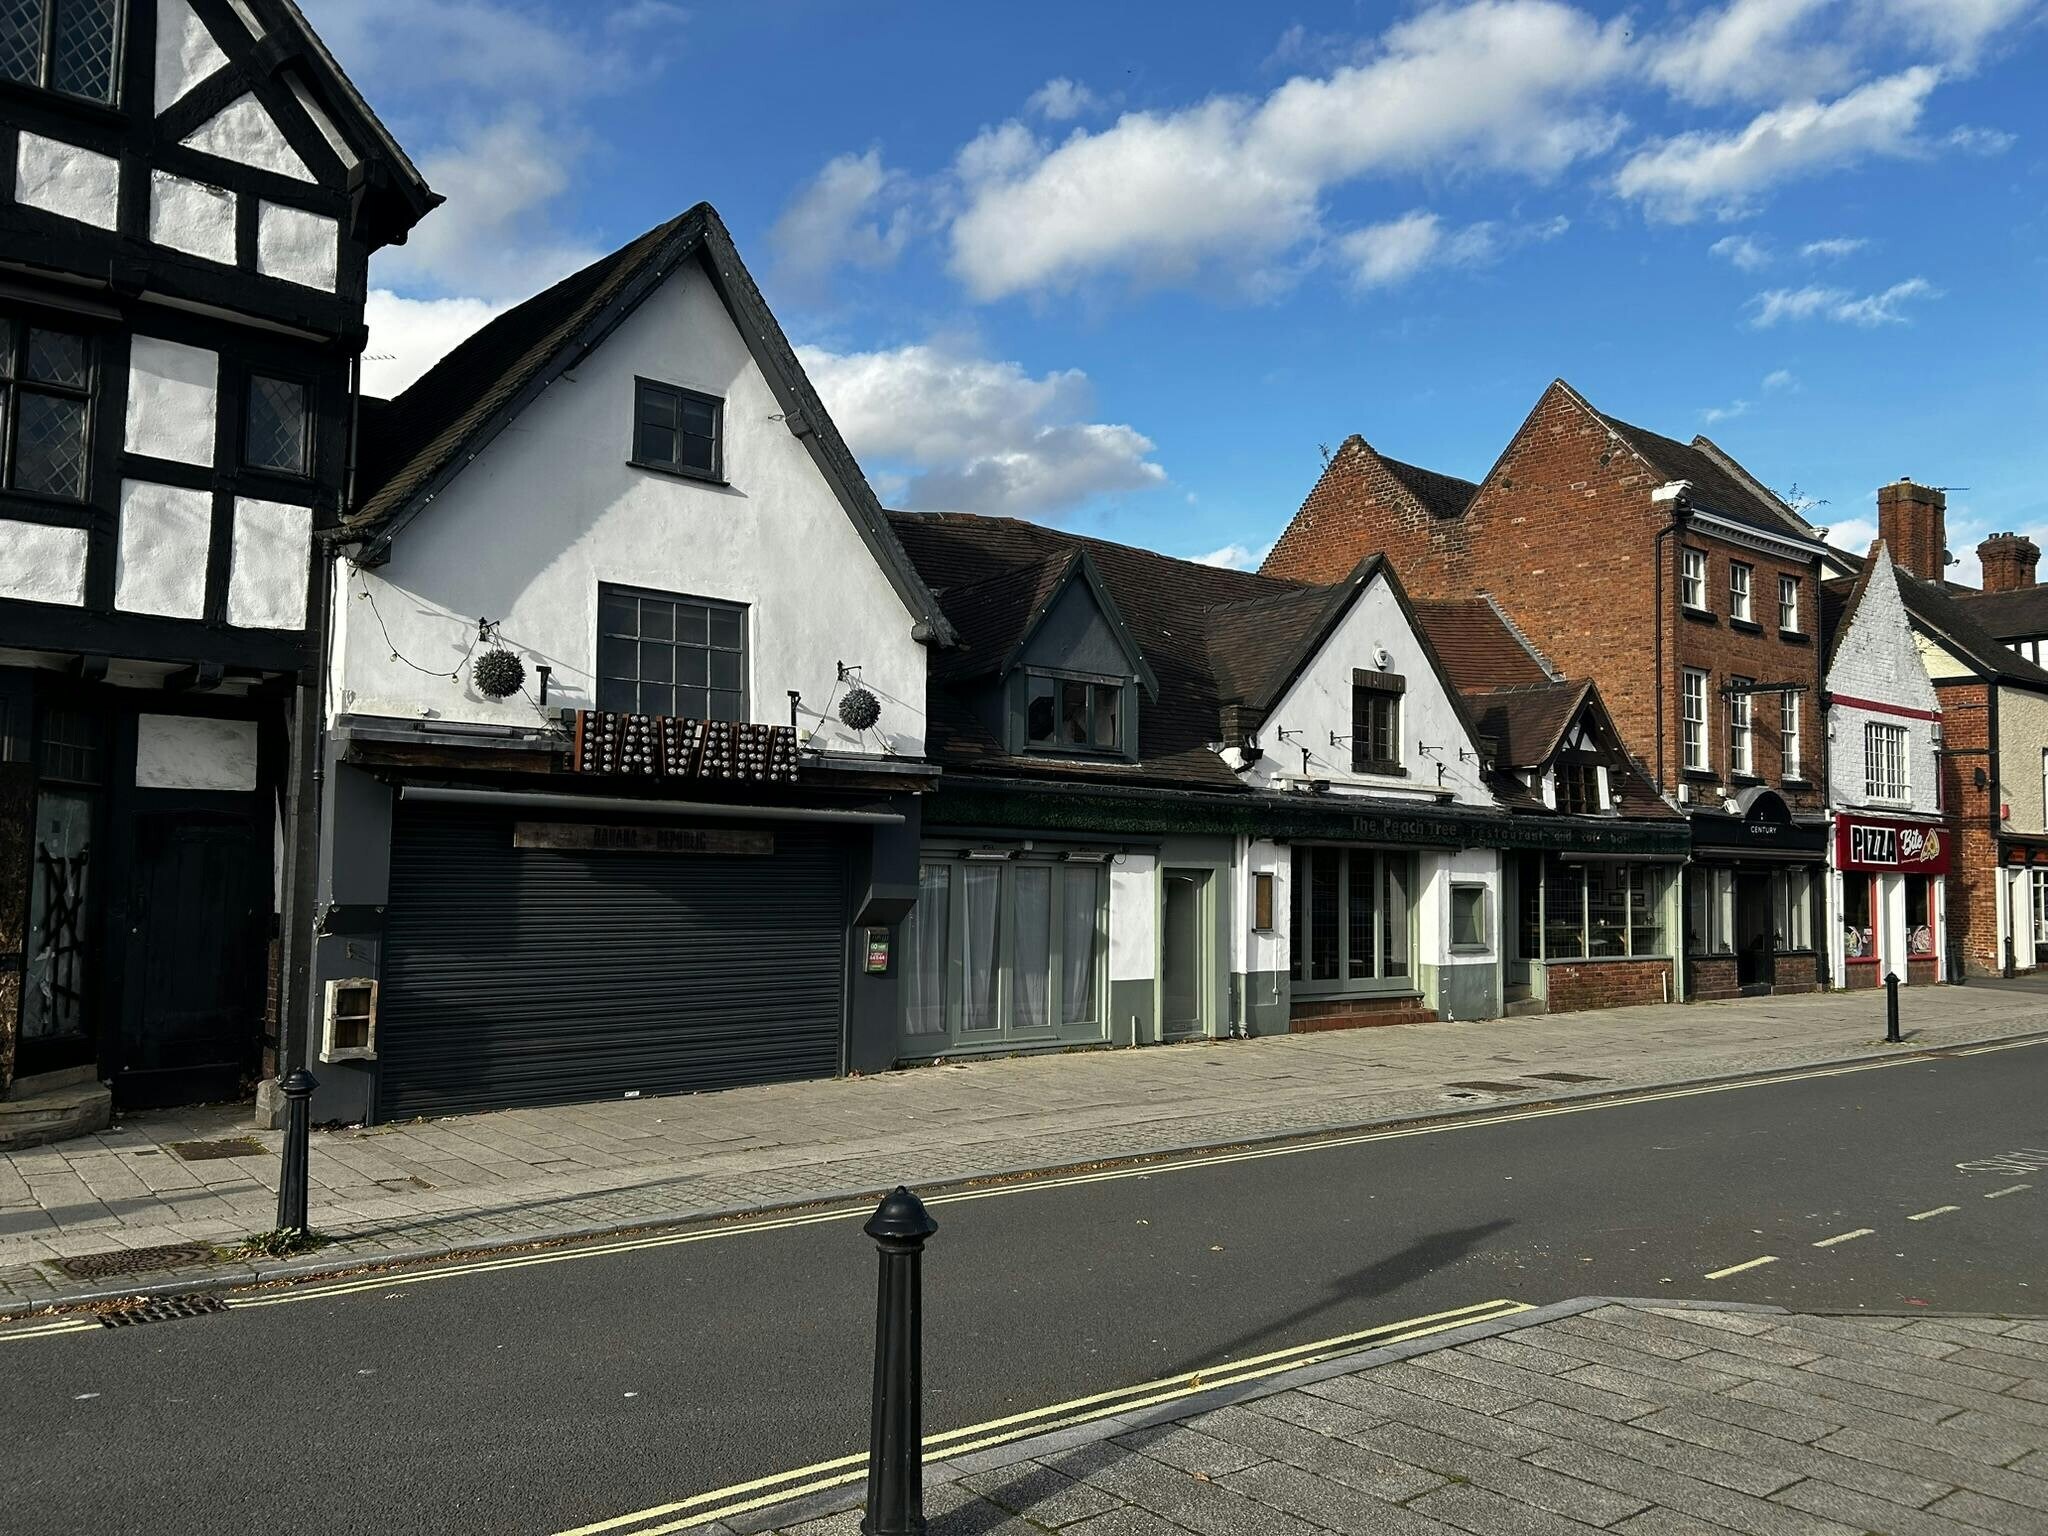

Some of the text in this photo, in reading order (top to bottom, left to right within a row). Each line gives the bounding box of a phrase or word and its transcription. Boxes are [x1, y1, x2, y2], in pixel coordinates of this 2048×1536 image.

[575, 710, 800, 784] HAVANA
[1351, 815, 1377, 832] The
[1384, 816, 1424, 835] Peach
[1750, 825, 1777, 835] CENTURY
[1851, 825, 1924, 865] PIZZA Bite
